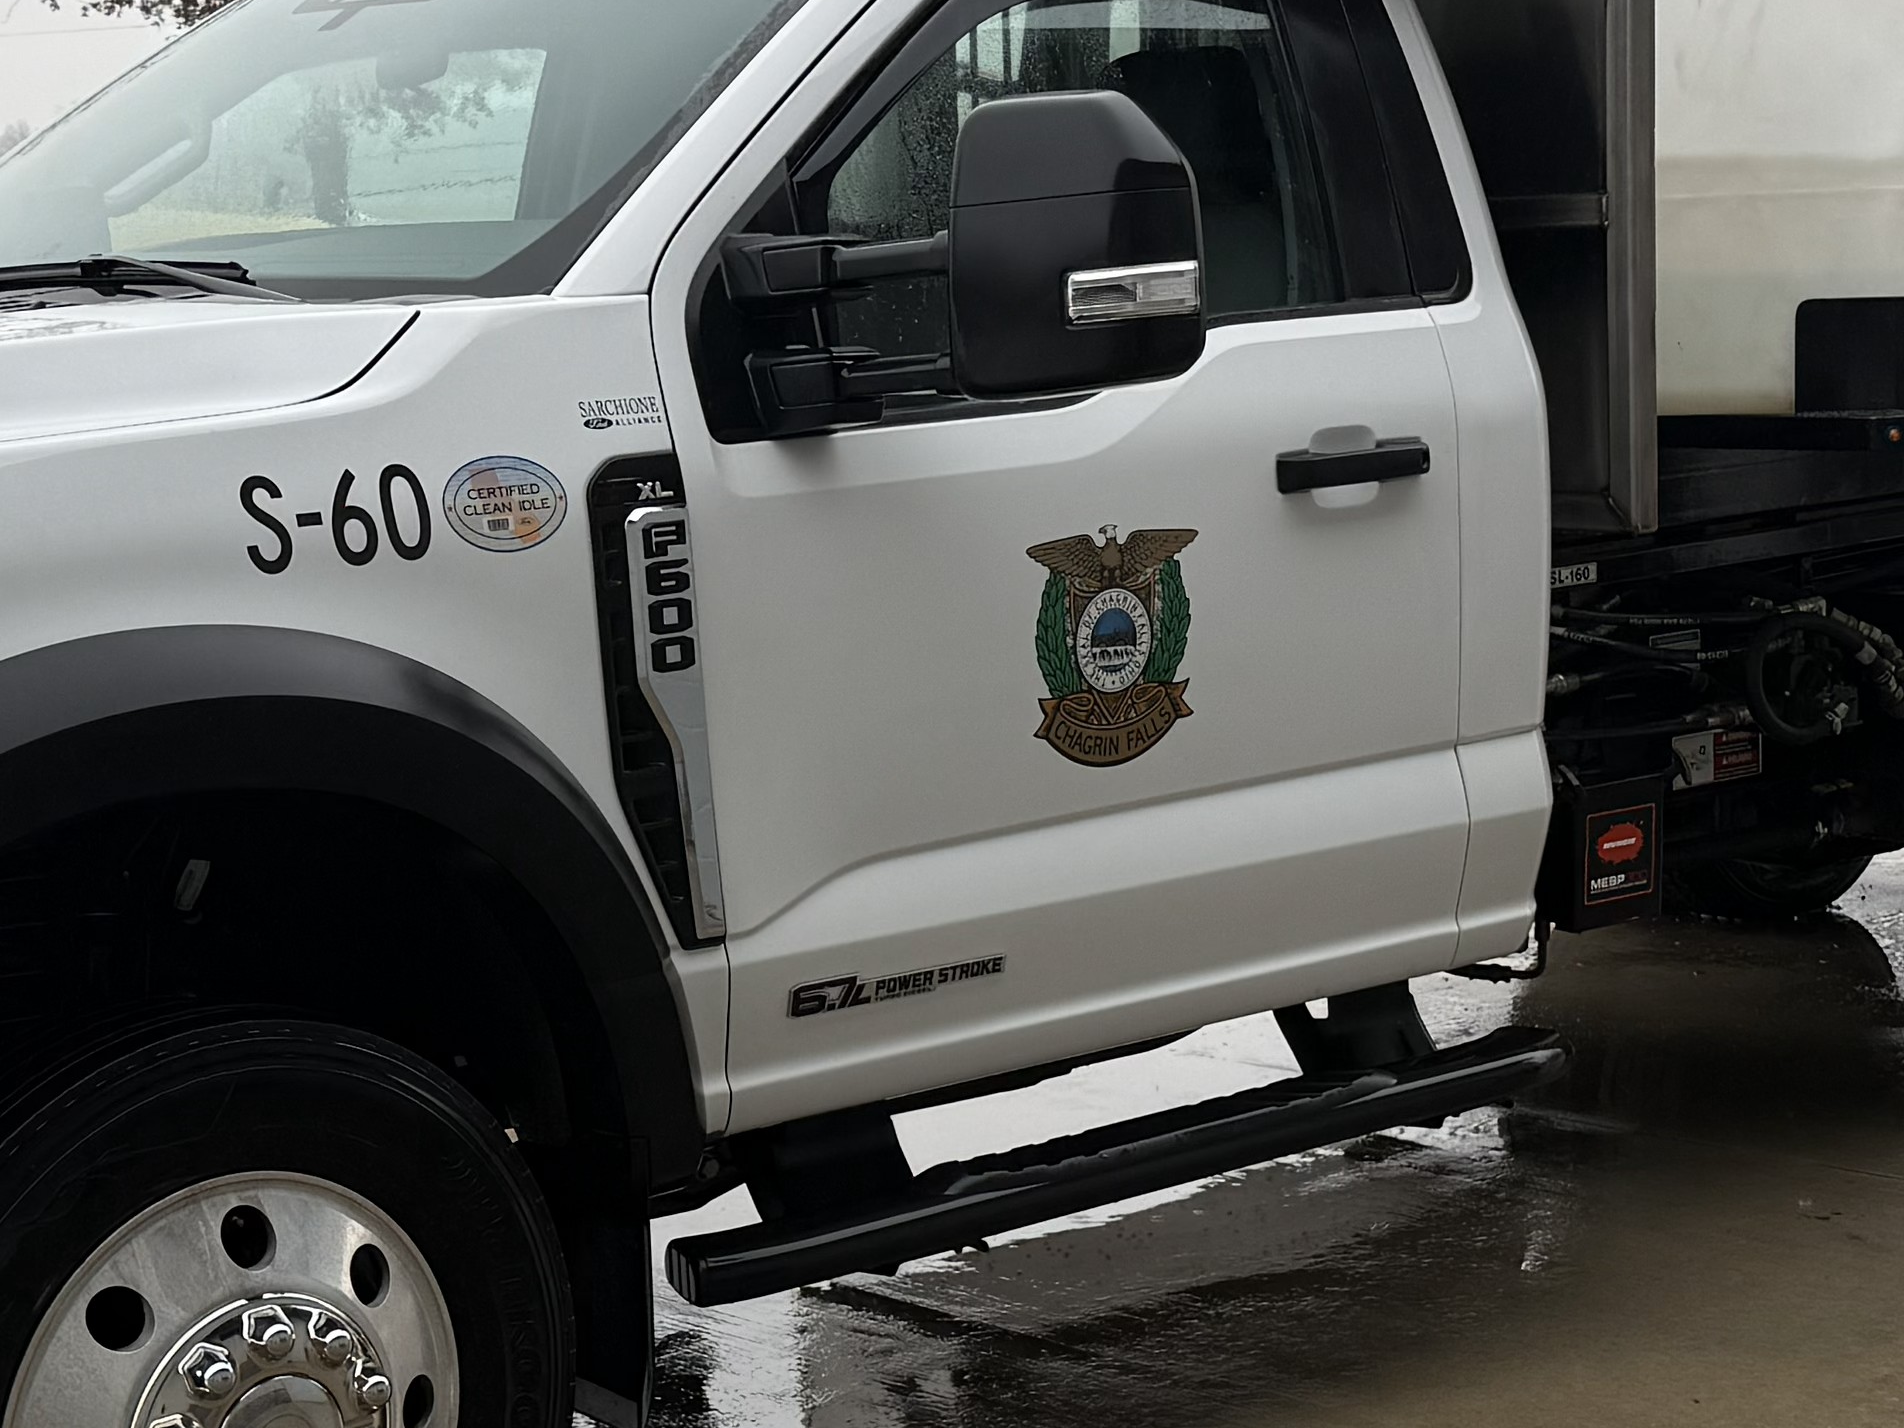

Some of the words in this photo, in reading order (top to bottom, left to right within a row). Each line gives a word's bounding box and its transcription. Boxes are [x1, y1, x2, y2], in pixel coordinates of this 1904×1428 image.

[578, 396, 659, 418] SARCHIONE
[615, 415, 662, 426] ALLIANCE
[467, 483, 540, 500] CERTIFIED
[636, 481, 674, 501] XL
[463, 502, 513, 516] CLEAN
[519, 498, 551, 511] IDLE
[239, 463, 432, 575] S-60
[642, 519, 696, 673] F600
[1054, 721, 1120, 757] CHAGRIN
[1126, 708, 1173, 752] FALLS
[875, 969, 935, 997] POWER
[937, 955, 1005, 985] STROKE
